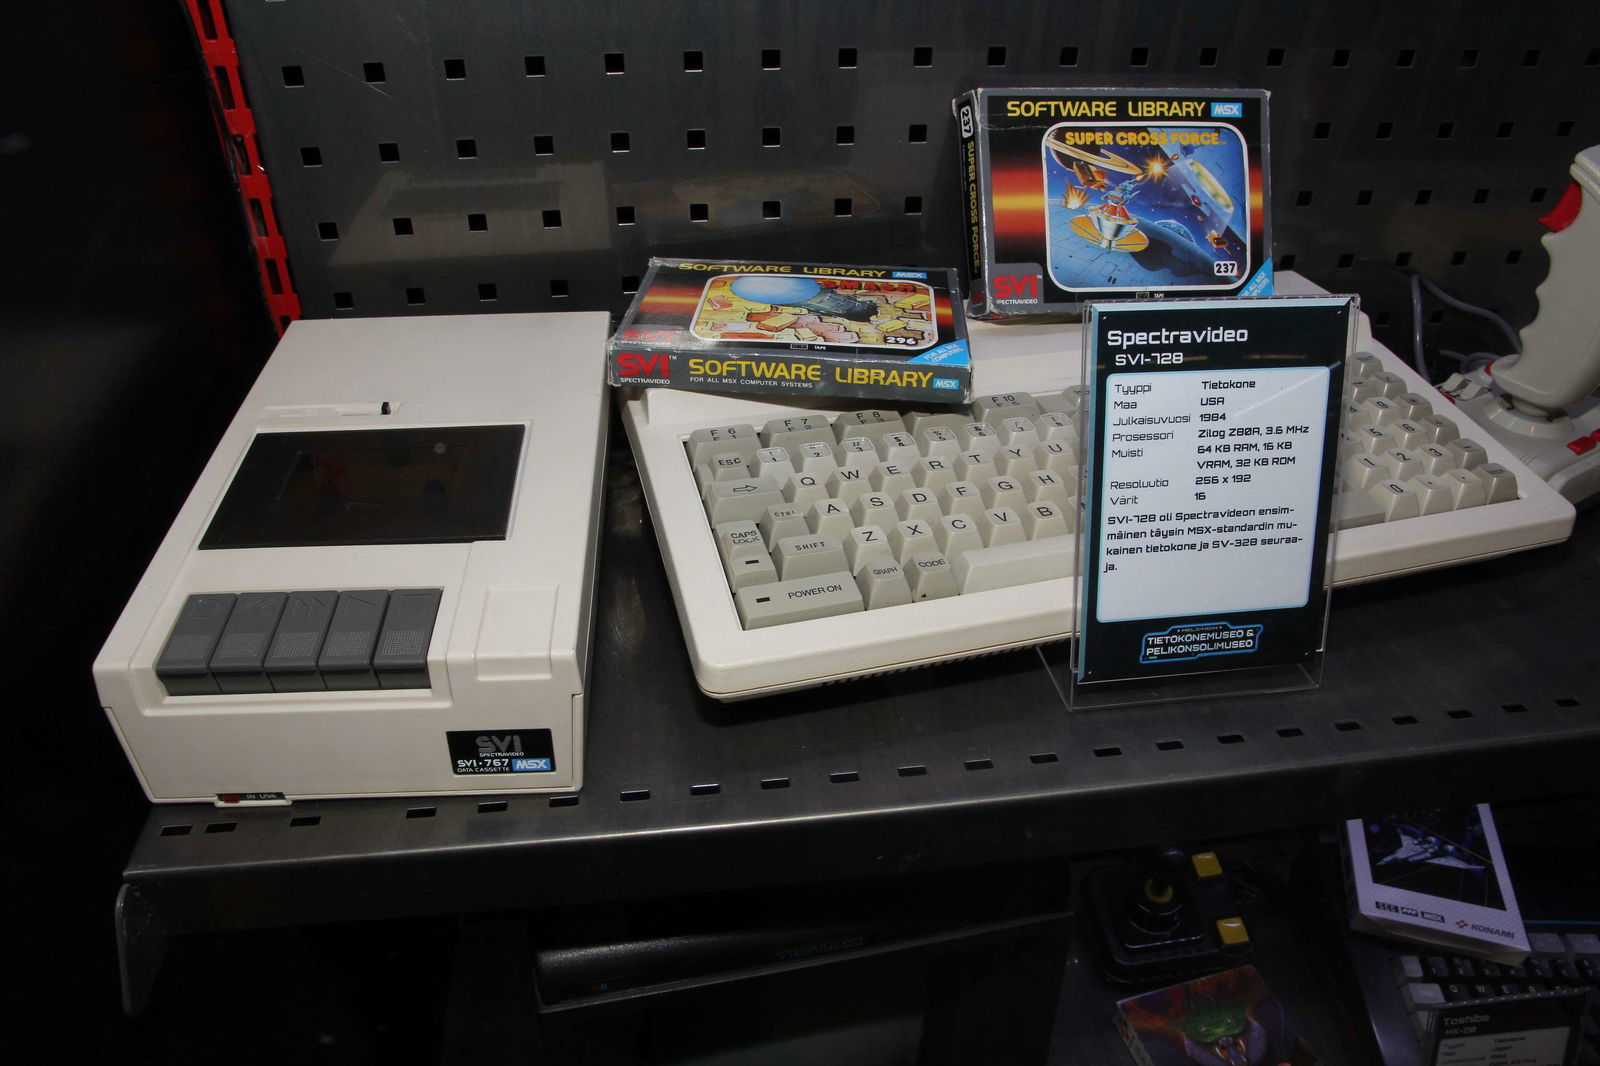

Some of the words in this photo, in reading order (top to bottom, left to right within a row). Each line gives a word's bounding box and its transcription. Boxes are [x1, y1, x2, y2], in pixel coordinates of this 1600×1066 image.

[1006, 100, 1117, 117] SOFTWARE
[1128, 101, 1206, 118] LIBRARY
[1213, 104, 1240, 116] MSX
[963, 108, 972, 135] 237
[1065, 131, 1114, 146] SUPER
[1115, 131, 1168, 146] CROSS
[1170, 131, 1220, 146] FORCE
[967, 141, 976, 183] SUPER
[968, 183, 979, 225] CROSS
[971, 227, 982, 268] FORCE
[679, 262, 792, 274] SOFTWARE
[803, 266, 886, 278] LIBRARY
[1215, 262, 1236, 274] 237
[992, 274, 1038, 298] SVI
[622, 329, 674, 341] SVI
[885, 336, 916, 345] 296
[1107, 326, 1249, 349] Spectravideo
[617, 352, 671, 378] SVI
[1115, 352, 1184, 366] SVI-728
[688, 359, 821, 382] SOFTWARE
[835, 366, 934, 389] LIBRARY
[620, 377, 671, 386] SPECTRAVIDEO
[722, 378, 738, 386] MSX
[740, 379, 778, 388] COMPUTER
[781, 381, 813, 389] SYSTEMS
[934, 379, 957, 389] MSX
[1115, 382, 1152, 395] Tyyppi
[1201, 379, 1256, 390] Tietokone
[1113, 400, 1138, 410] Maa
[1200, 396, 1225, 407] USA
[1113, 414, 1191, 427] Julkaisuvuosi
[1199, 413, 1227, 422] 1984
[1112, 430, 1174, 442] Prosessori
[1198, 427, 1226, 440] Zilog
[1228, 427, 1263, 437] Z80A,
[1265, 425, 1283, 435] 3.6
[1285, 424, 1310, 434] MHz
[1008, 448, 1021, 458] Y
[1048, 443, 1063, 453] U
[1111, 447, 1144, 459] Muisti
[1197, 445, 1212, 454] 64
[1214, 444, 1231, 454] KB
[1232, 443, 1260, 453] RAM,
[1262, 442, 1275, 451] 16
[1276, 441, 1293, 451] KB
[1428, 447, 1443, 457] 3
[718, 457, 741, 467] ESC
[968, 454, 981, 463] T
[1396, 452, 1411, 461] 2
[886, 465, 901, 474] E
[929, 460, 944, 470] R
[1196, 459, 1233, 471] VRAM,
[1235, 458, 1251, 467] 32
[1253, 457, 1269, 467] KB
[1271, 456, 1296, 466] ROM
[841, 469, 859, 480] W
[1038, 475, 1055, 484] H
[800, 476, 817, 486] Q
[998, 481, 1014, 490] G
[1110, 478, 1169, 490] Resoluutio
[1195, 475, 1219, 486] 256
[1222, 476, 1229, 484] x
[1231, 474, 1252, 483] 192
[956, 486, 967, 495] F
[870, 497, 884, 507] S
[912, 493, 927, 503] D
[1110, 494, 1139, 506] Värit
[1194, 491, 1206, 501] 16
[774, 510, 798, 518] CTRL
[827, 503, 841, 514] A
[1036, 506, 1053, 517] B
[994, 512, 1008, 522] V
[1107, 513, 1157, 526] SVI-728
[1159, 511, 1173, 522] oli
[1175, 507, 1256, 523] Spectravideon
[1258, 505, 1295, 517] ensim-
[906, 524, 923, 535] X
[951, 519, 966, 529] C
[730, 530, 758, 539] CAPS
[862, 530, 878, 542] Z
[1106, 528, 1147, 541] mäinen
[1150, 526, 1185, 540] täysin
[1187, 521, 1274, 536] MSX-standardin
[1276, 520, 1298, 530] mu-
[733, 536, 760, 545] LOCK
[794, 541, 826, 551] SHIFT
[1106, 545, 1143, 556] kainen
[1145, 541, 1197, 554] tietokone
[1197, 540, 1209, 552] ja
[1211, 537, 1258, 549] SV-328
[1260, 536, 1303, 546] seuraa-
[918, 558, 946, 568] CODE
[1103, 561, 1118, 574] ja.
[872, 566, 898, 576] GRAPH
[788, 587, 825, 600] POWER
[826, 584, 842, 594] ON
[1146, 629, 1244, 645] TIETOKONEMUSEO
[1245, 628, 1255, 638] &
[1146, 638, 1254, 656] PELIKONSOLIMUSEO
[476, 735, 522, 752] SVI
[515, 759, 548, 770] MSX
[1471, 923, 1515, 940] KONAMI
